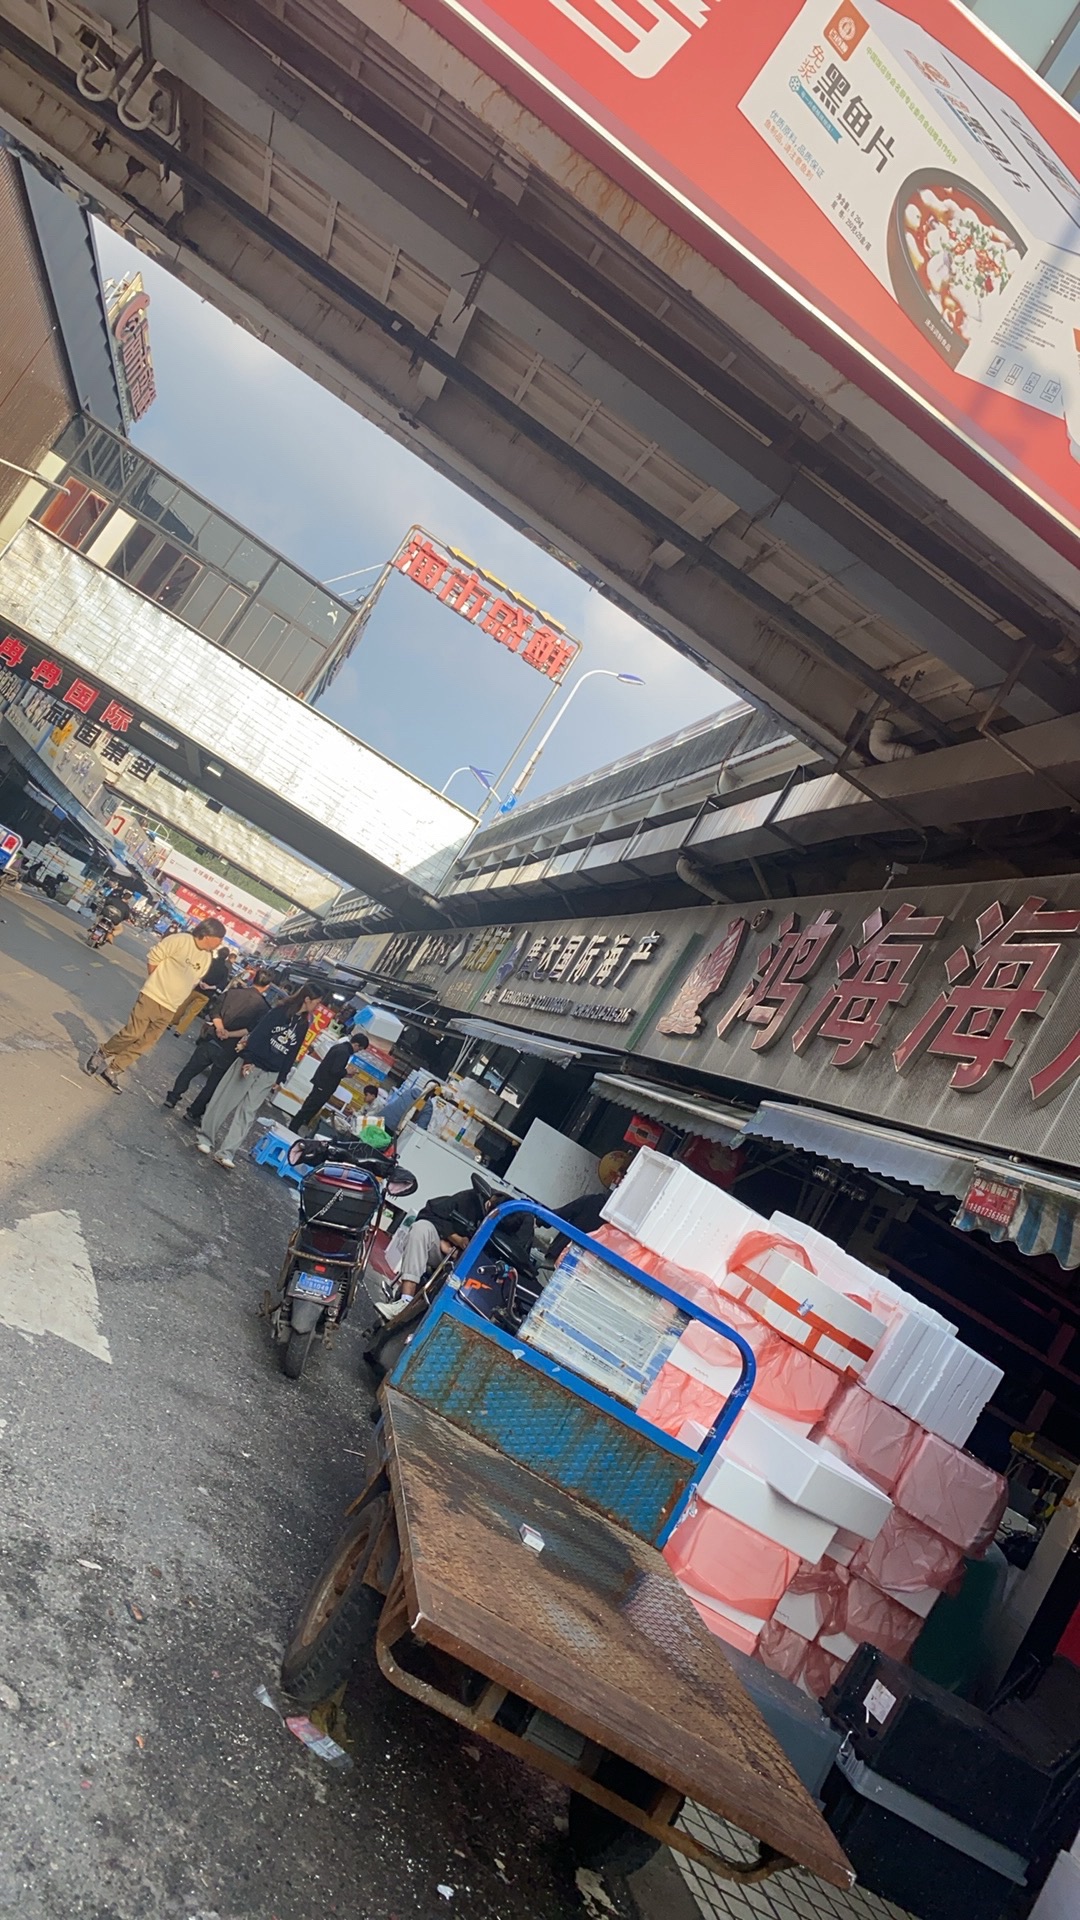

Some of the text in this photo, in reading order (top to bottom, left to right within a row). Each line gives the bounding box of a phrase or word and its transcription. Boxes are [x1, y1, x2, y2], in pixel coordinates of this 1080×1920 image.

[797, 45, 825, 84] 免浆
[812, 63, 895, 173] 黑鱼片
[716, 895, 1080, 1101] 鸿海海
